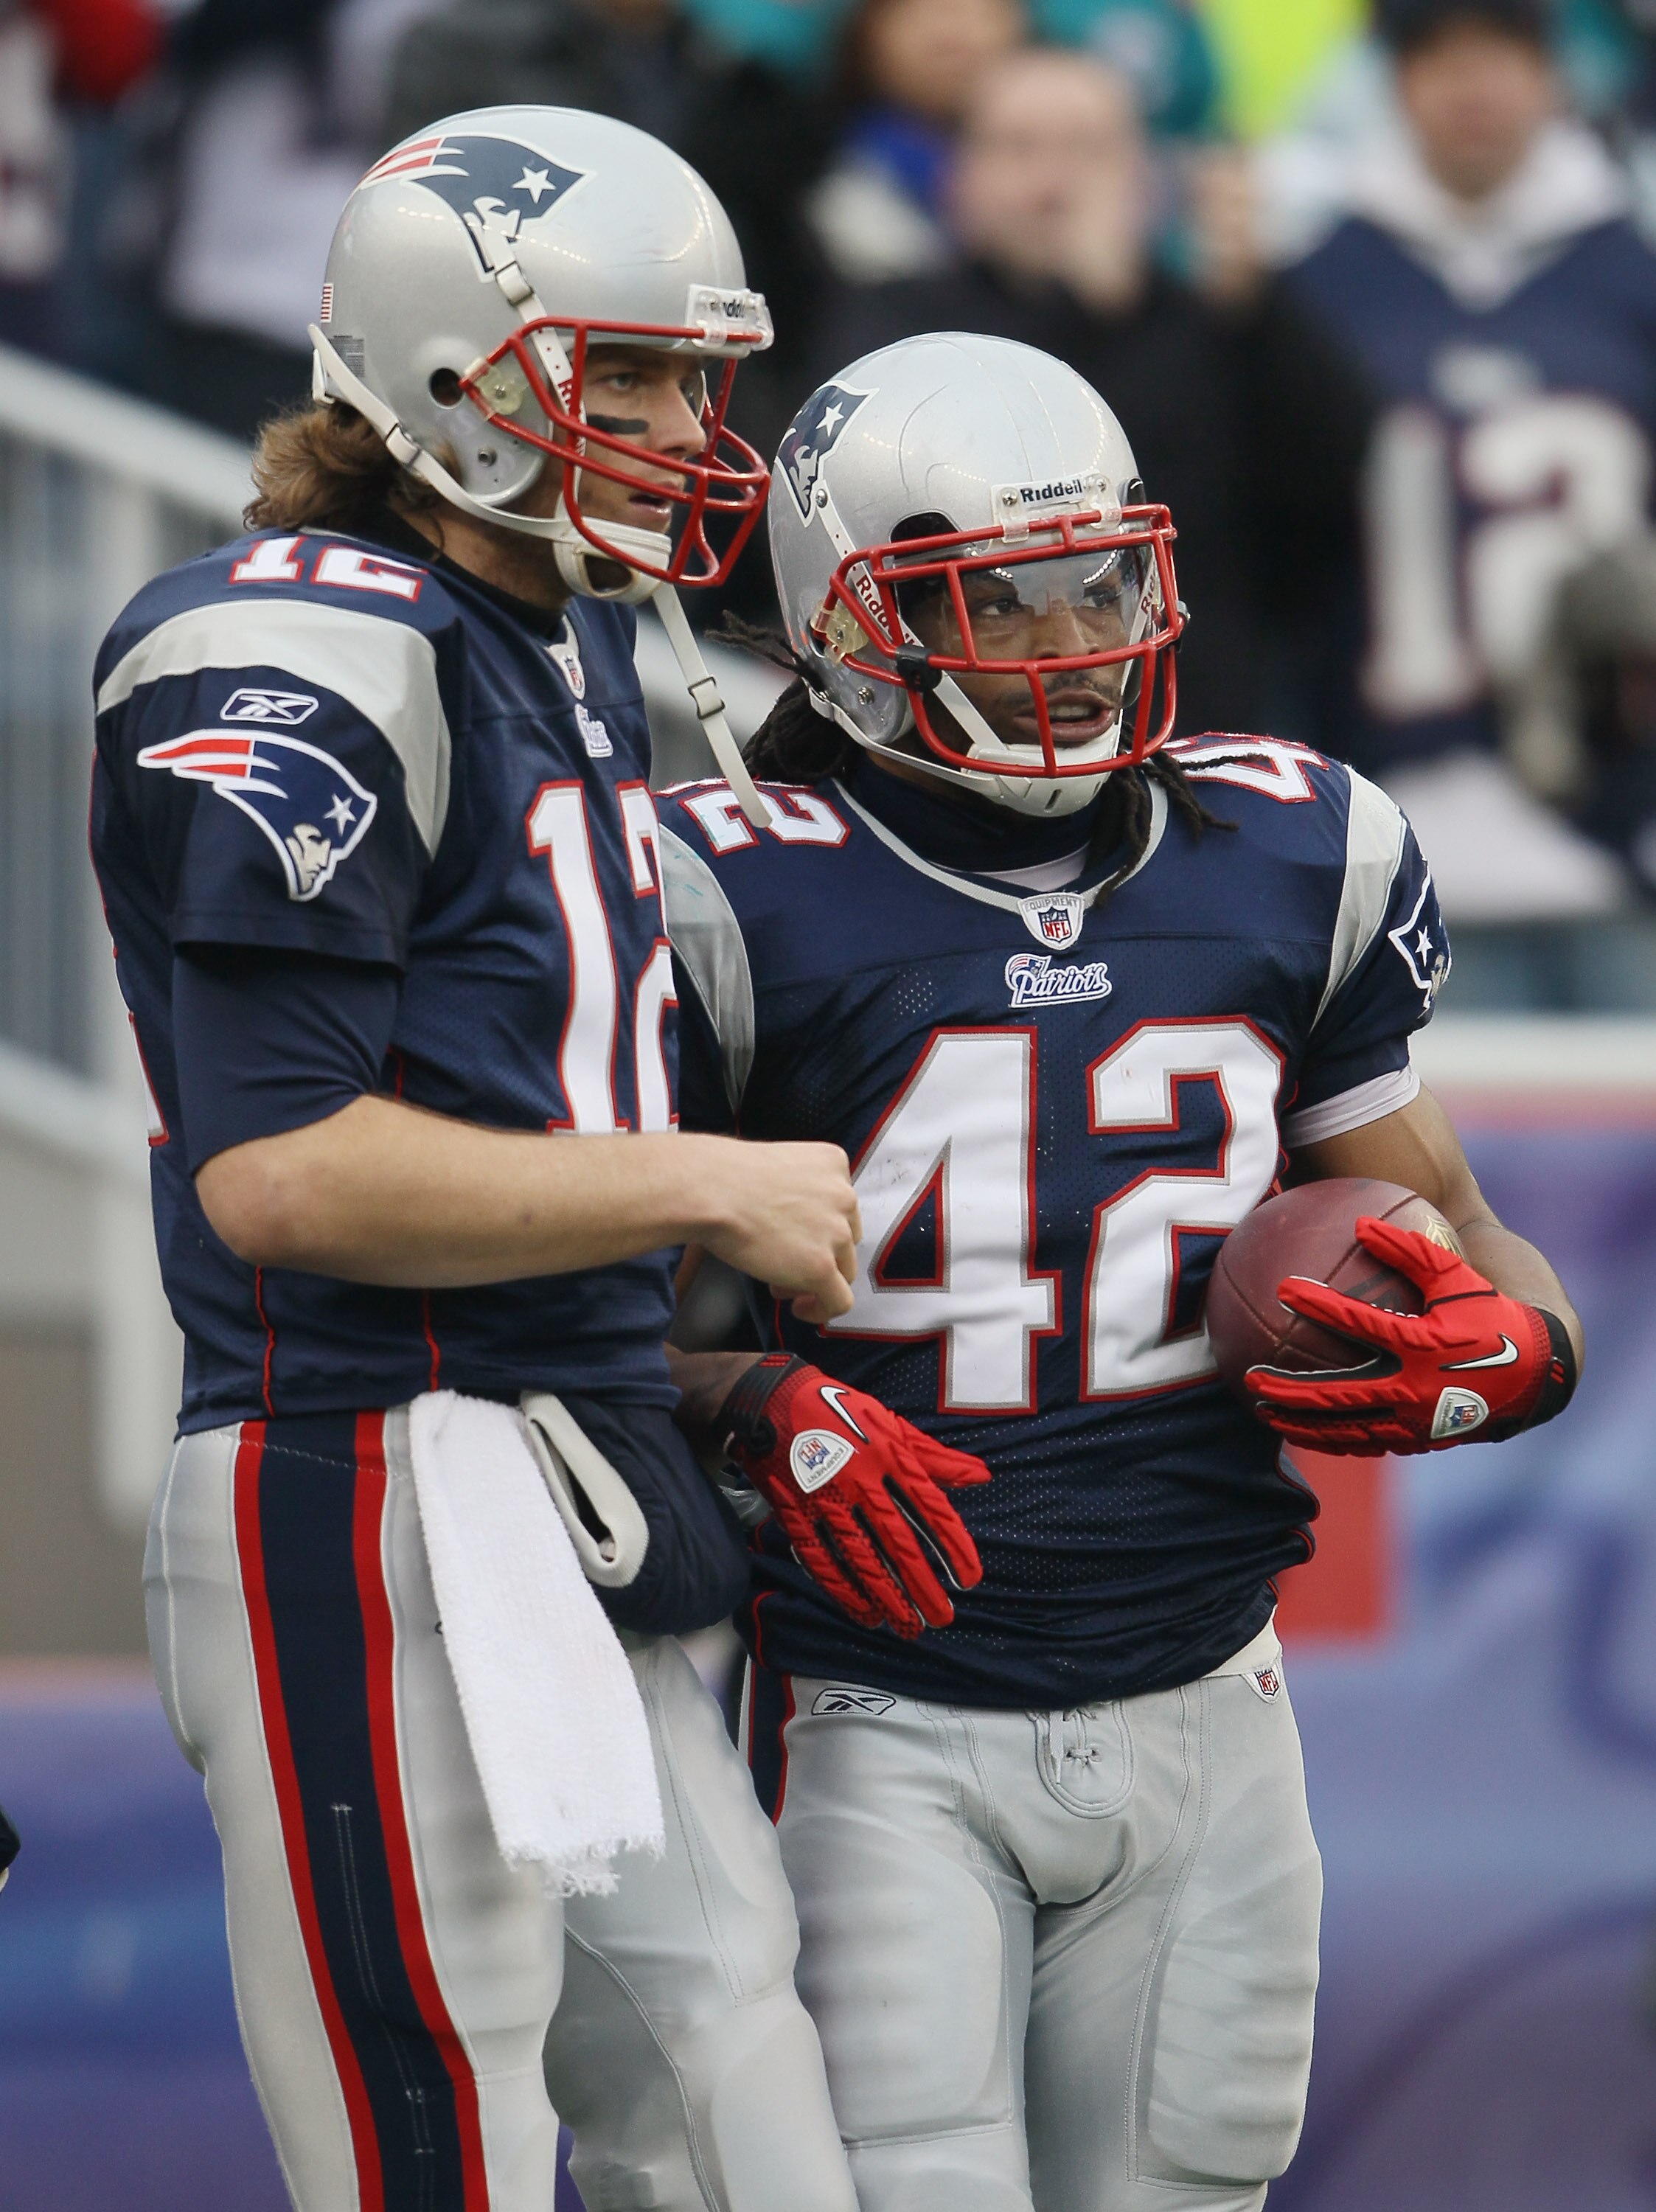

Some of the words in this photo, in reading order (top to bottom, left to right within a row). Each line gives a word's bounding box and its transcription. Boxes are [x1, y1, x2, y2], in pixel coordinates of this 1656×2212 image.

[229, 535, 429, 602] 12
[1025, 897, 1079, 912] EQUIPMENT
[1044, 922, 1069, 939] NFL
[1010, 964, 1108, 1004] Patriots
[817, 1015, 1286, 1415] 42
[800, 1440, 821, 1460] NFL
[1259, 1672, 1277, 1691] NFL
